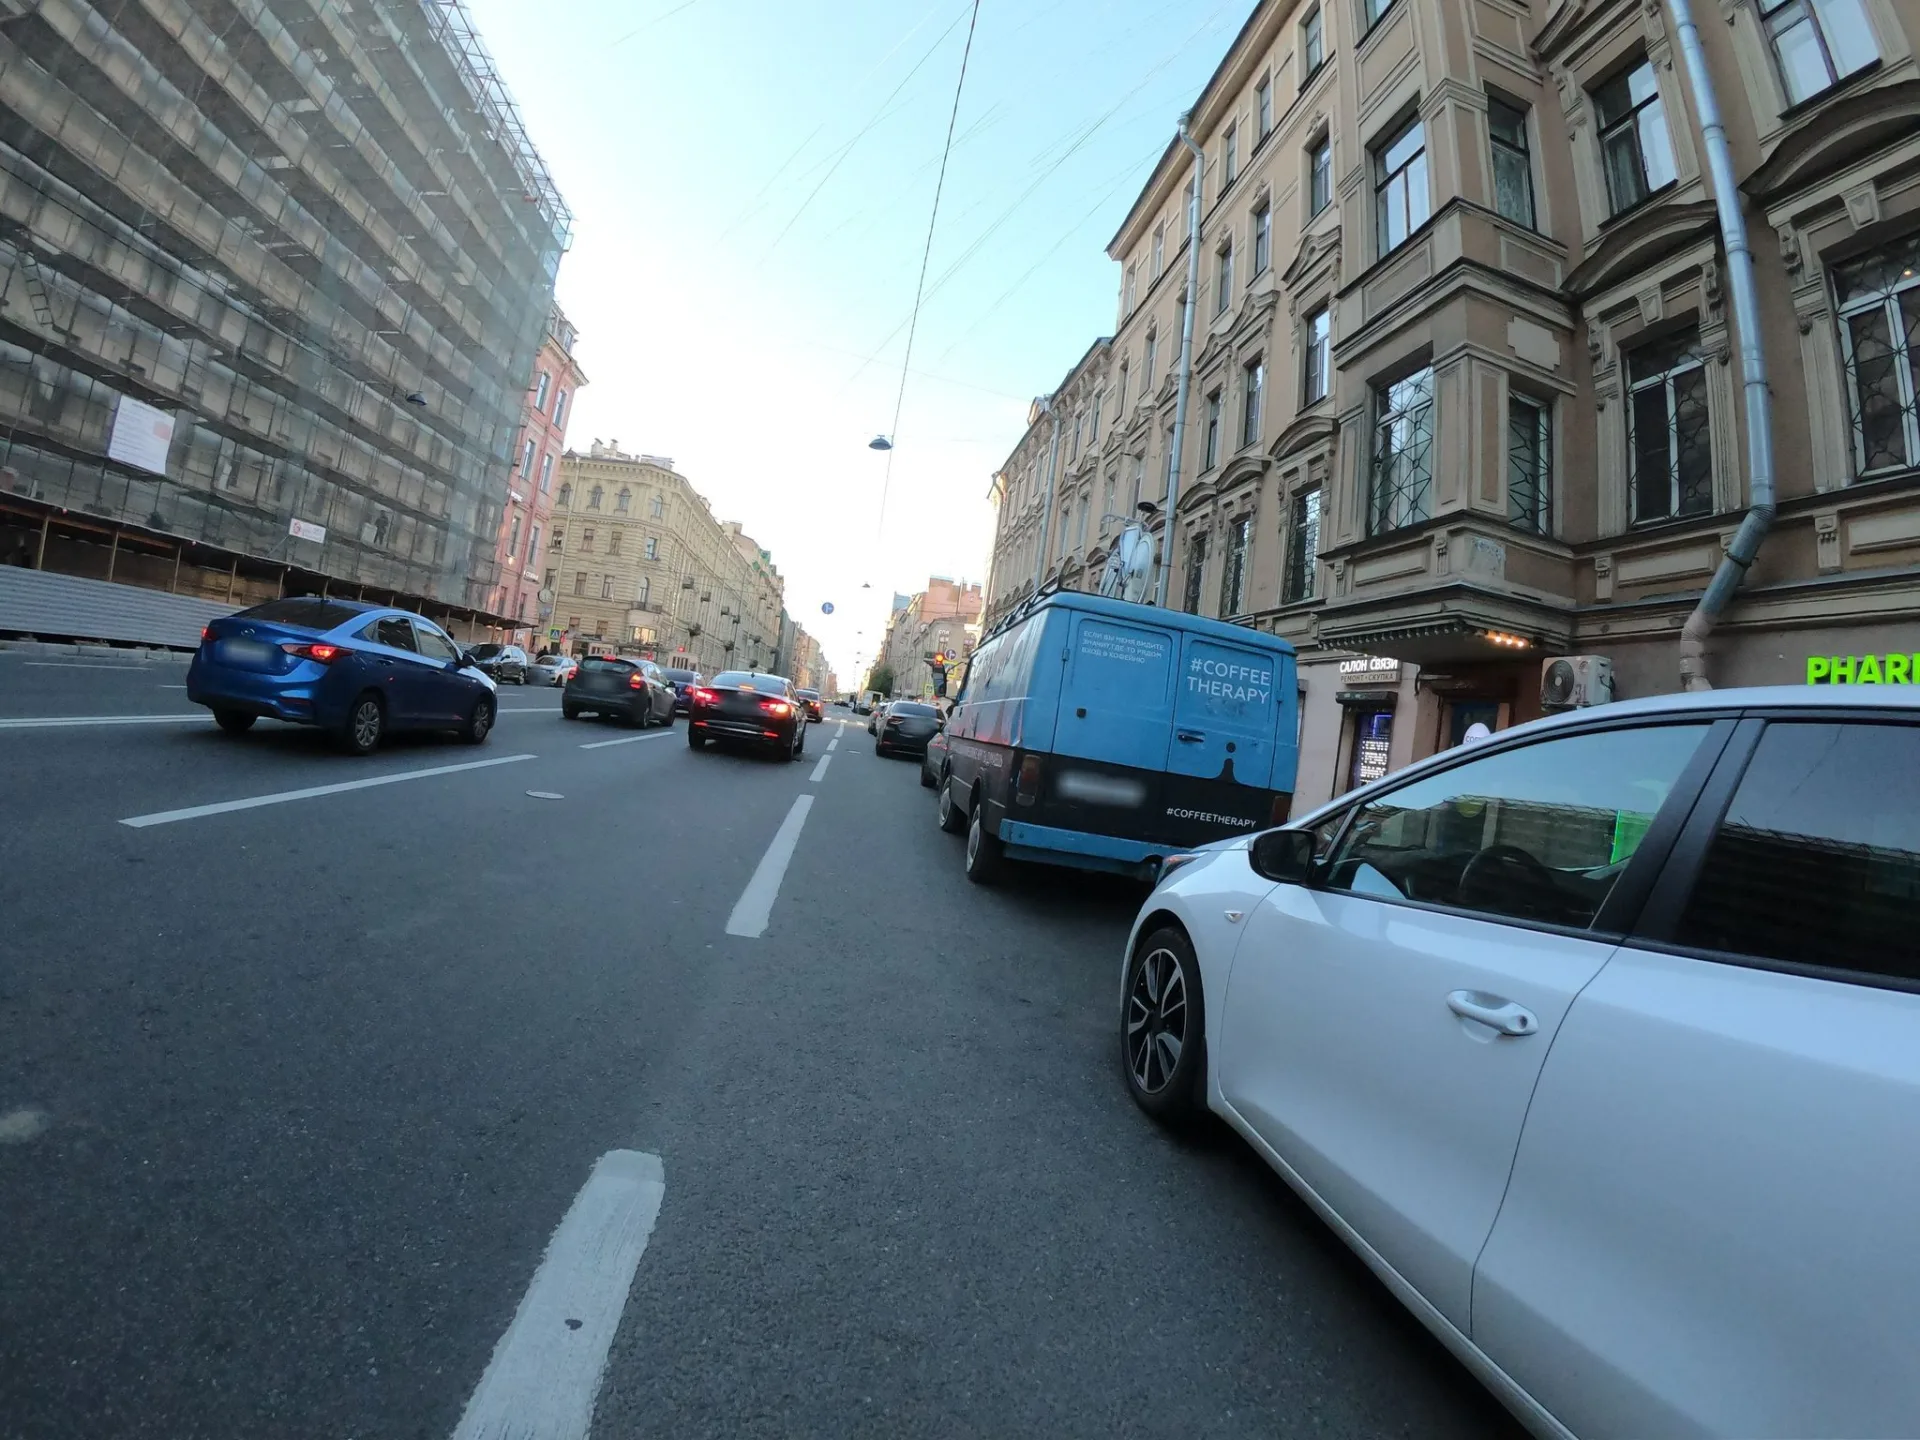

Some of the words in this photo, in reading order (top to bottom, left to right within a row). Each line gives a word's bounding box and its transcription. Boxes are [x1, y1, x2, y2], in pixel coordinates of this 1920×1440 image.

[1190, 658, 1271, 686] #COFFEE
[1340, 659, 1368, 673] САЛОН
[1370, 657, 1399, 670] СВЯЗИ
[1340, 674, 1365, 682] РЕМОНТ
[1368, 673, 1394, 681] СКУПКА
[1187, 676, 1270, 705] THERAPY
[1166, 807, 1257, 828] #COFFEETHERAPY
